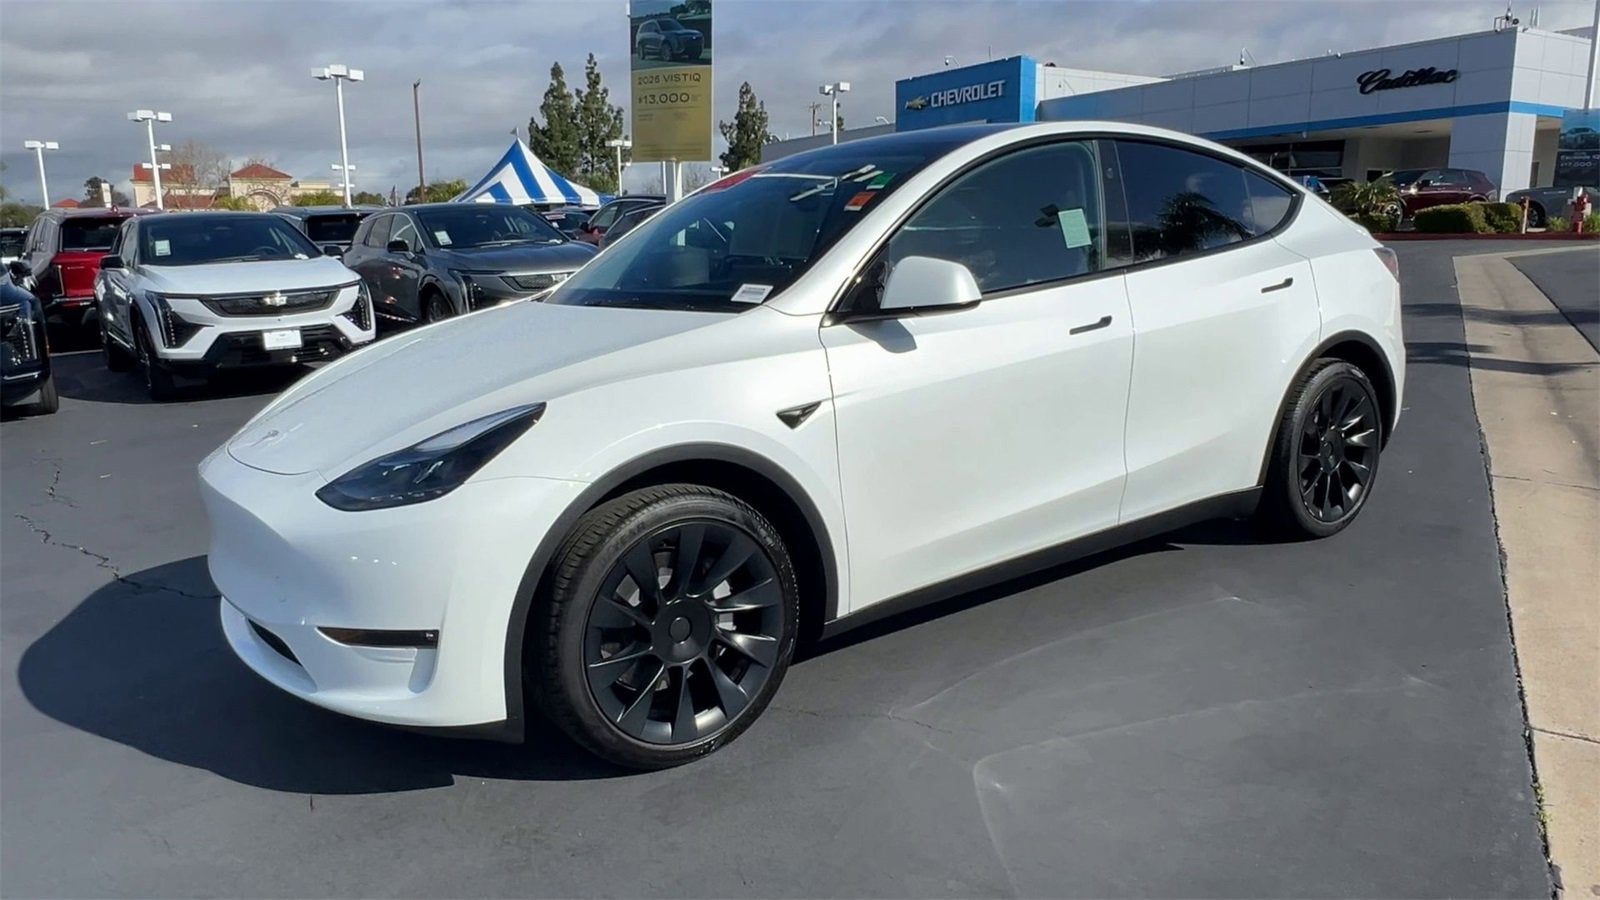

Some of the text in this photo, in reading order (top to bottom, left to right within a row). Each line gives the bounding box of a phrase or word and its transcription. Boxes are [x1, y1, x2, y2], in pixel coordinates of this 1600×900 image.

[662, 72, 702, 83] VISTIQ
[1357, 66, 1459, 95] Cadillac
[930, 79, 1006, 108] CHEVROLET
